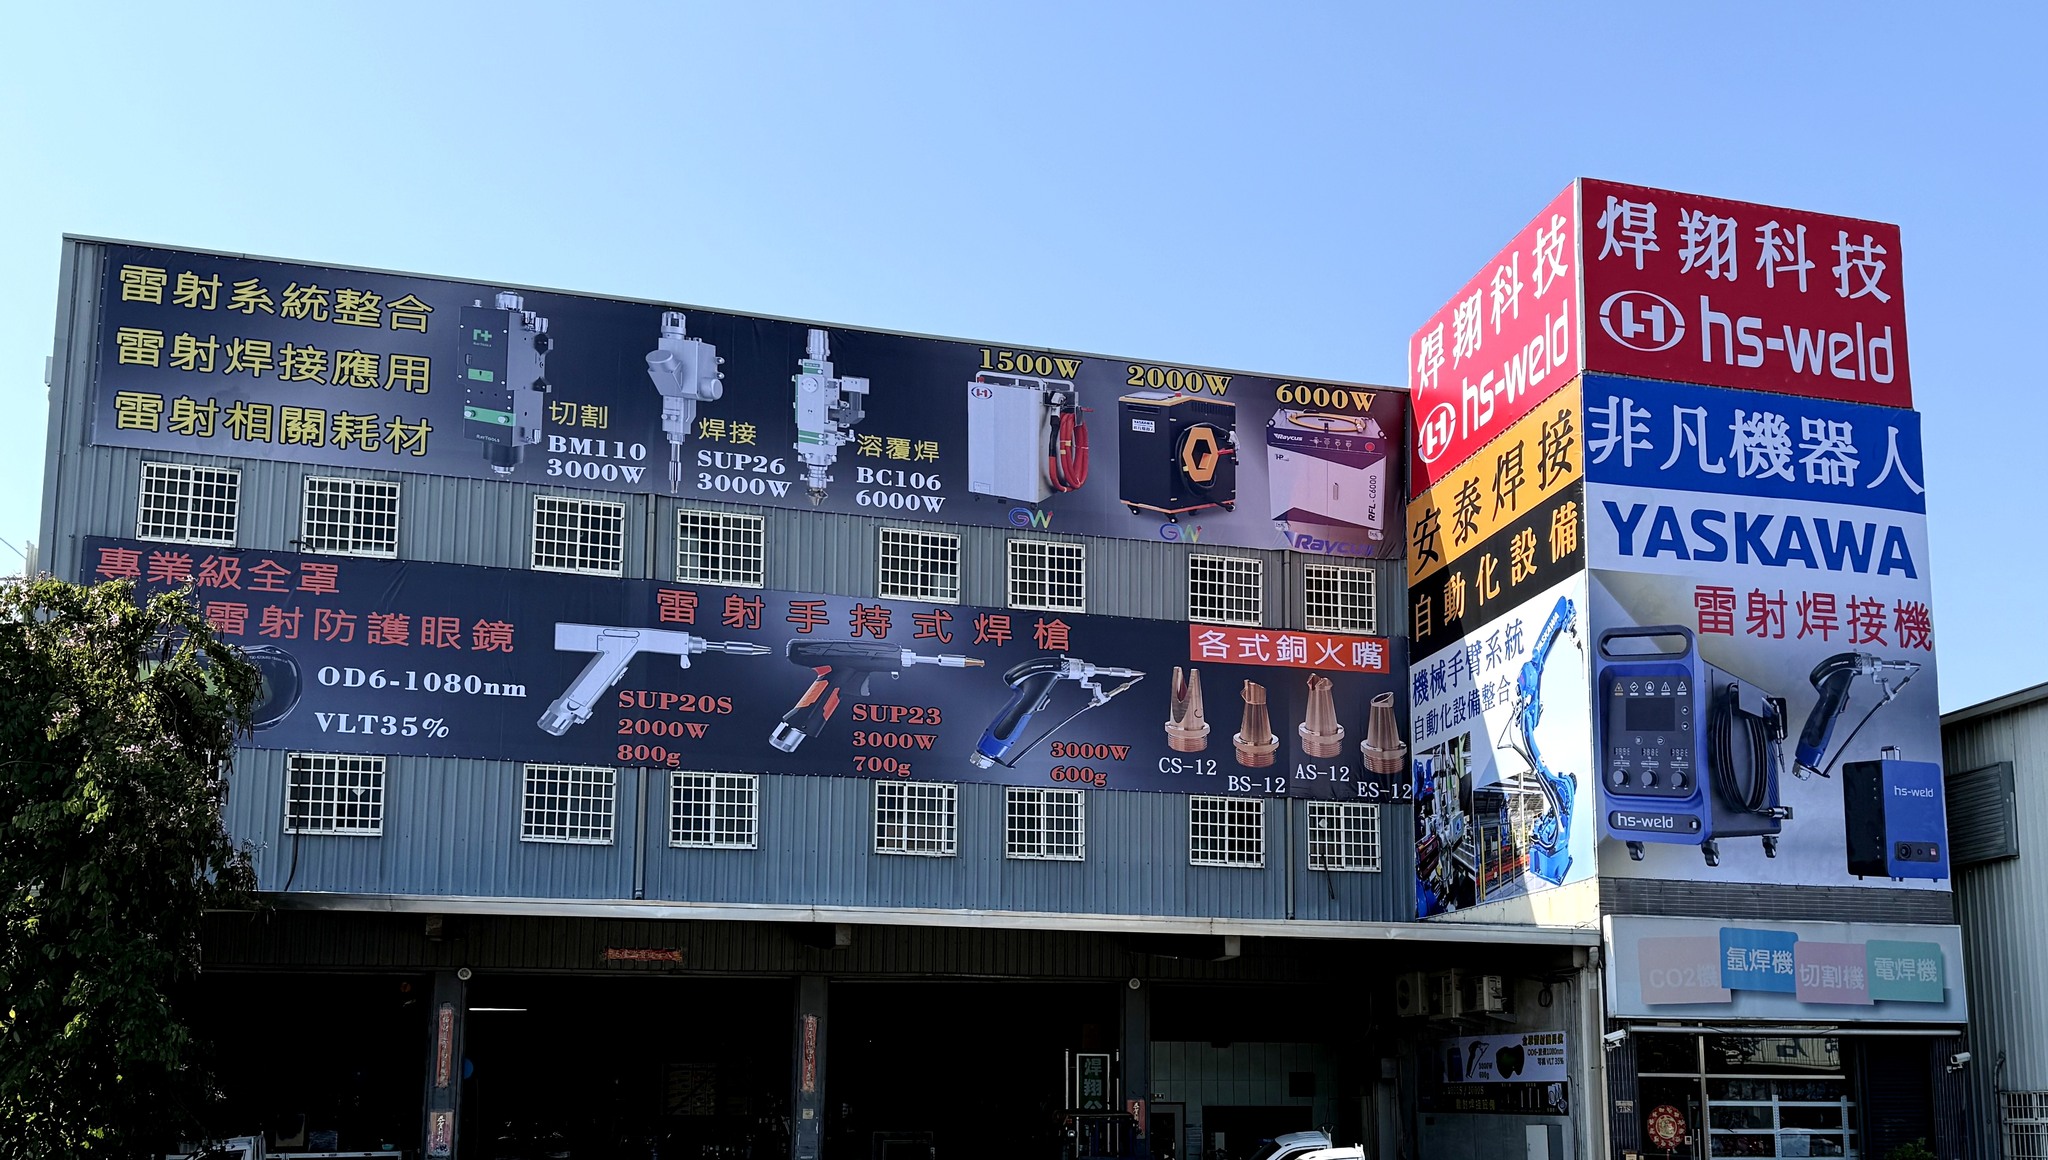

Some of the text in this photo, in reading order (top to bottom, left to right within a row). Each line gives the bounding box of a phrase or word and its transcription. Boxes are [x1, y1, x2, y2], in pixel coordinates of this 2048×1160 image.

[1597, 195, 1891, 304] 焊翔科技
[118, 264, 435, 334] 雷射系統整合
[1416, 213, 1569, 401] 焊翔科技
[1700, 295, 1894, 384] hs-weld
[116, 326, 433, 395] 雷射焊接應用
[979, 347, 1083, 381] 1500W
[1461, 298, 1570, 440] hs-weld
[1127, 365, 1233, 397] 2000W
[1275, 384, 1377, 414] 6000W
[114, 390, 434, 458] 雷射相關耗材
[549, 402, 609, 430] 切割
[699, 417, 757, 446] 焊接
[1587, 395, 1925, 496] 非凡機器人
[548, 435, 647, 461] BM110
[857, 433, 940, 464] 溶覆焊
[547, 458, 646, 484] 3000W
[698, 450, 786, 475] SUP26
[697, 473, 792, 498] 3000W
[856, 467, 942, 490] BC106
[1413, 408, 1575, 577] 安泰焊接
[855, 489, 946, 514] 6000W
[1602, 500, 1918, 580] YASKAWA
[96, 547, 340, 595] 專業級全罩
[1415, 501, 1578, 643] 自動化設備
[204, 600, 515, 654] 雷射防護眼鏡
[656, 587, 1072, 652] 雷射手持式焊槍
[1694, 584, 1933, 652] 雷射焊接機
[1198, 629, 1384, 670] 各式銅火嘴
[1412, 618, 1525, 708] 機械手臂系統
[317, 666, 528, 698] OD6-1080nm
[618, 689, 734, 716] SUP20S
[852, 703, 943, 726] SUP23
[1414, 674, 1511, 744] 自動化設備整合
[315, 712, 450, 739] VLT35%
[617, 717, 710, 740] 2000W
[852, 730, 938, 751] 3000W
[1050, 741, 1132, 763] 3000W
[616, 743, 682, 768] 800g
[853, 755, 912, 778] 700g
[1158, 757, 1218, 777] CS-12
[1050, 765, 1108, 787] 600g
[1227, 775, 1286, 794] BS-12
[1294, 763, 1351, 783] AS-12
[1357, 781, 1412, 799] ES-12
[1894, 785, 1934, 798] hs-weld
[1617, 813, 1674, 829] hs-weld
[1726, 946, 1794, 975] 氬焊機
[1874, 957, 1938, 983] 電焊機
[1651, 964, 1719, 989] CO2機
[1798, 964, 1865, 991] 切割機
